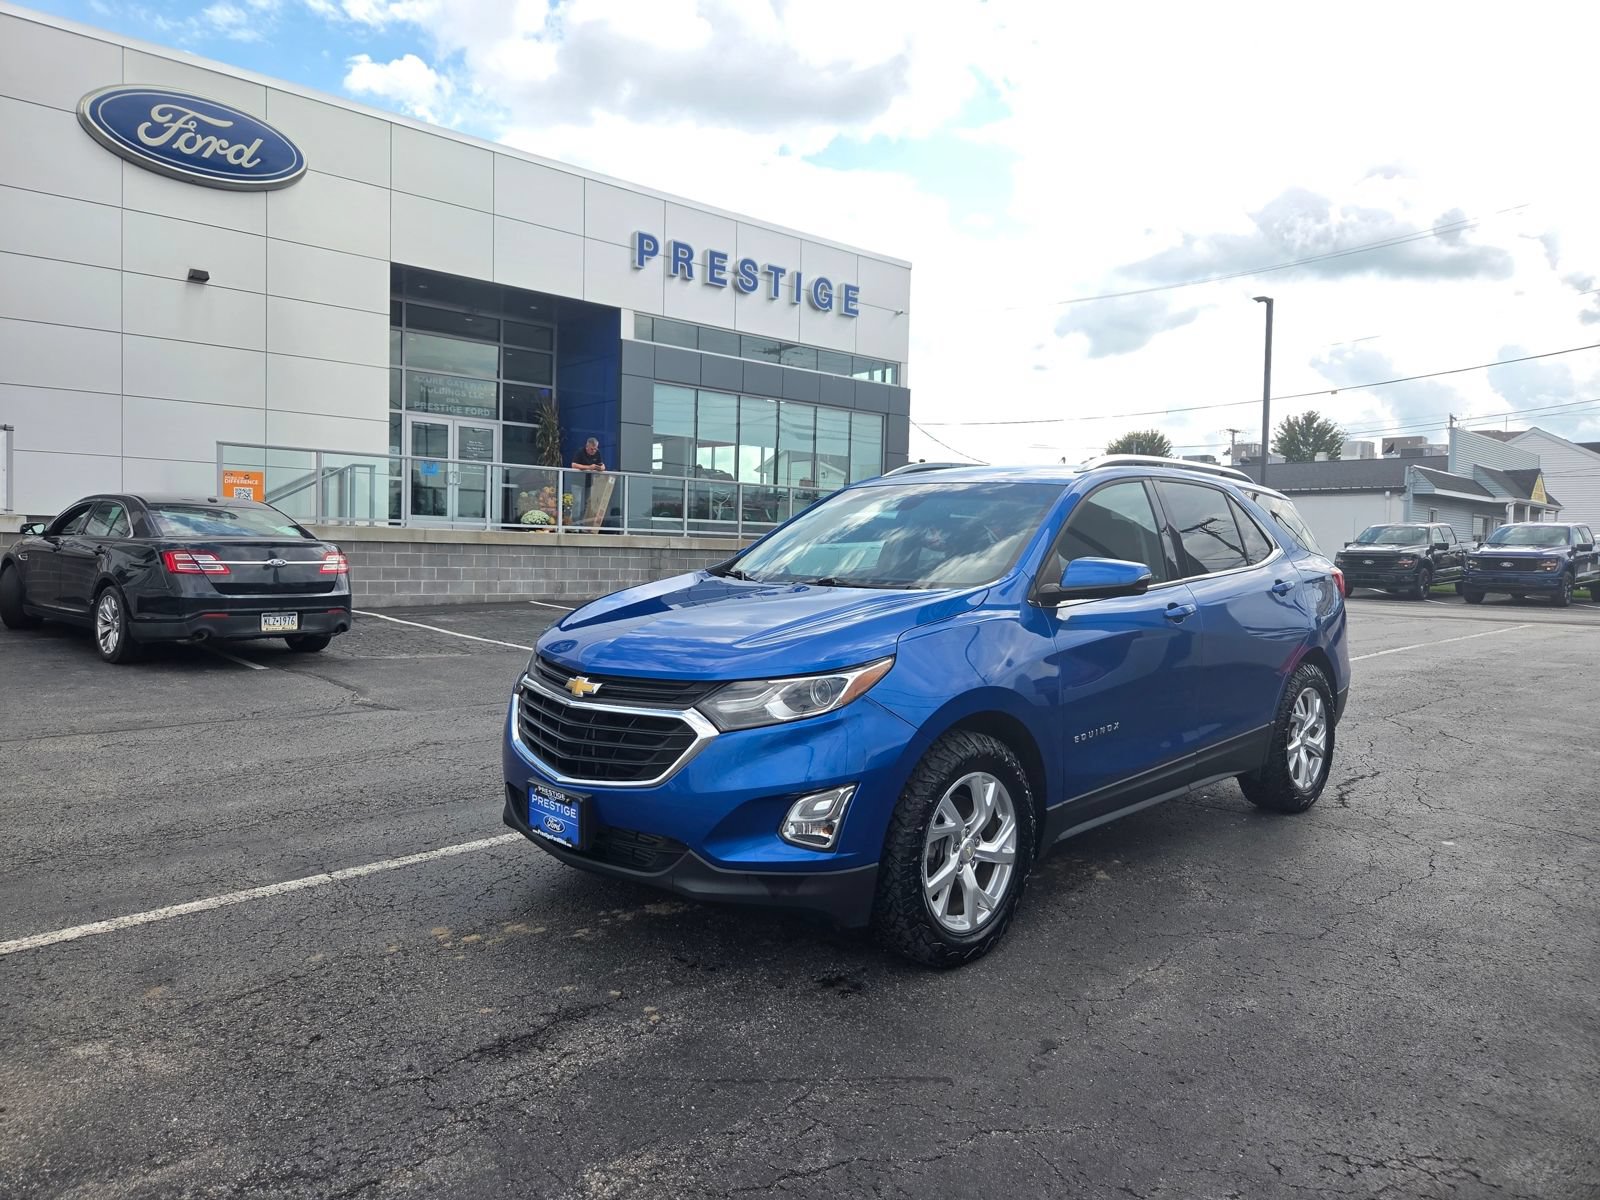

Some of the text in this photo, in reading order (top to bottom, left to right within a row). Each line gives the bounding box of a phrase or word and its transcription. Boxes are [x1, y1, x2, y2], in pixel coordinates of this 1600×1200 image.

[137, 104, 264, 168] Ford
[632, 231, 860, 317] PRESTIGE
[420, 385, 466, 397] HOLDINGS
[414, 401, 490, 416] PRESTIGE FORD
[1074, 721, 1120, 743] EQUINOX
[531, 794, 577, 819] PRESTIGE
[547, 817, 561, 831] Ford
